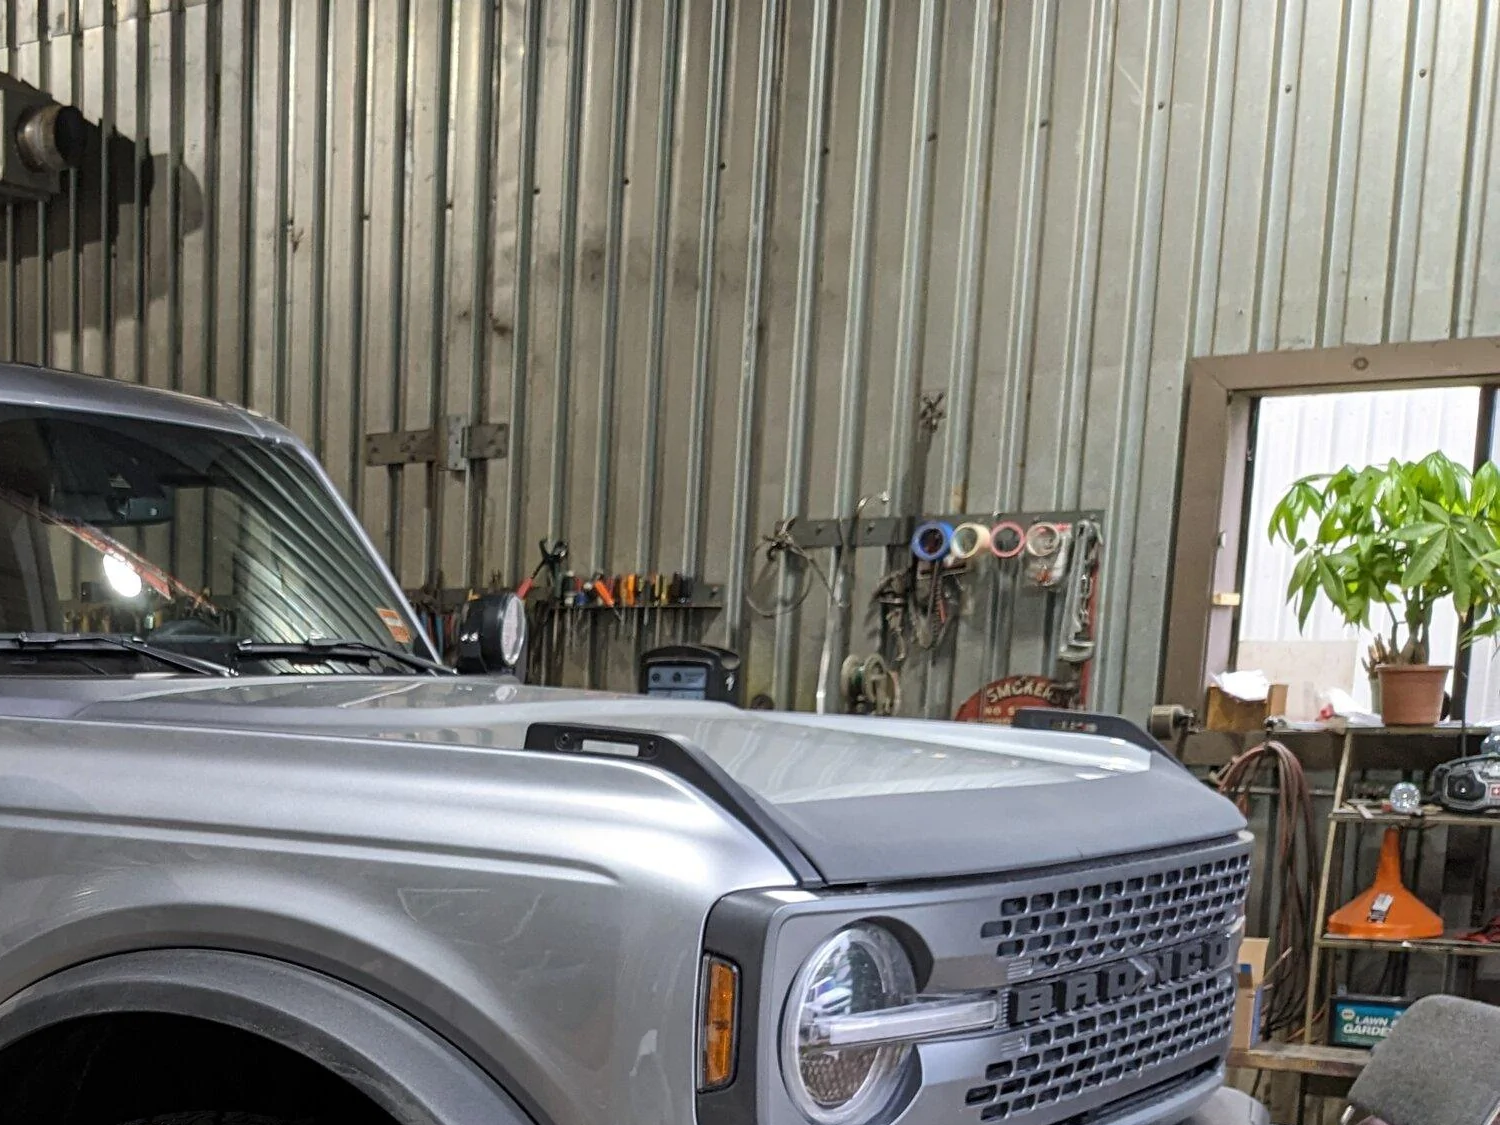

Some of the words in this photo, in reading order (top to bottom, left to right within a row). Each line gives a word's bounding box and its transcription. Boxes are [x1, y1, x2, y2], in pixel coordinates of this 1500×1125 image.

[1009, 939, 1229, 1025] BRONCO
[1355, 1015, 1389, 1027] LAWN
[1343, 1023, 1393, 1037] GARDE
